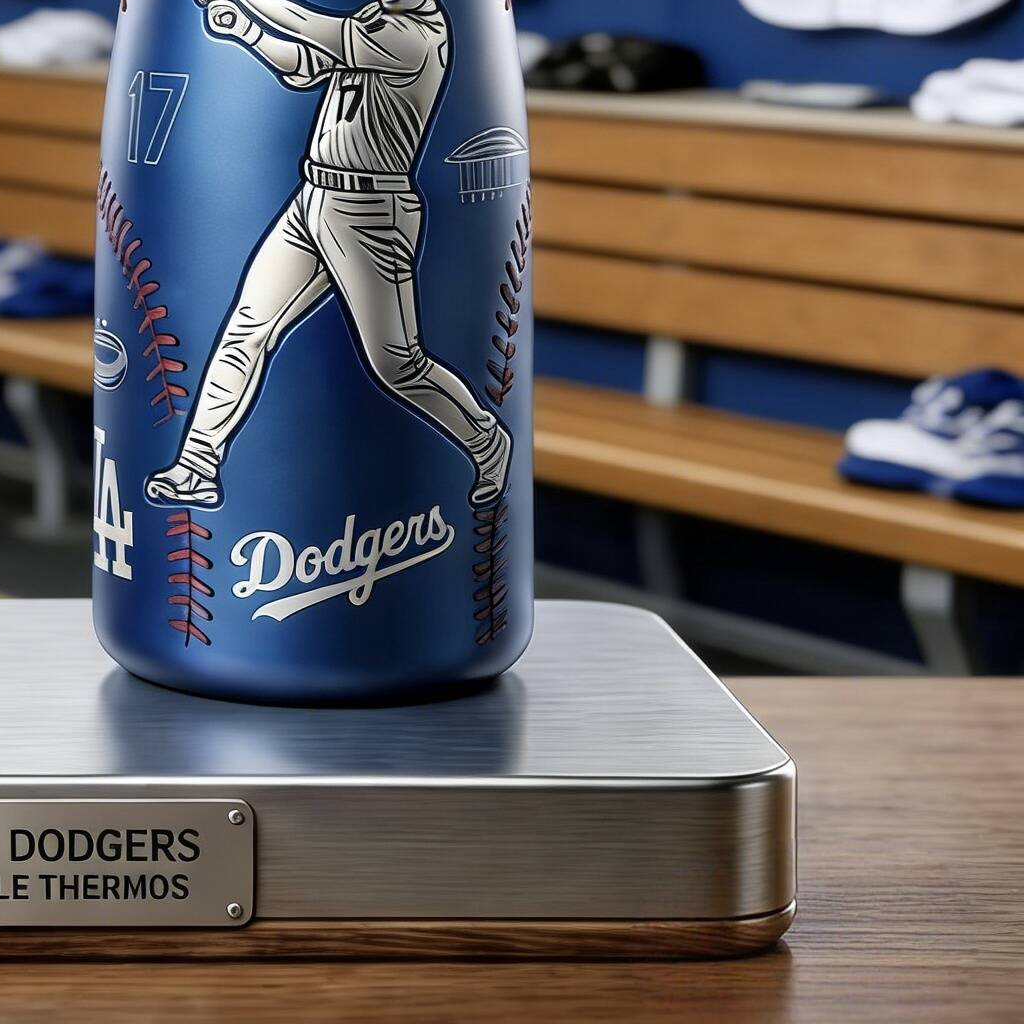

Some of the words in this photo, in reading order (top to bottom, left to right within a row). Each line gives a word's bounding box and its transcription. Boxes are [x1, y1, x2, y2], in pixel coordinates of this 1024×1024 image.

[127, 70, 190, 166] 17
[93, 425, 134, 581] LA
[230, 504, 456, 623] Dodgers
[9, 828, 202, 864] DODGERS
[38, 873, 190, 901] THERMOS
